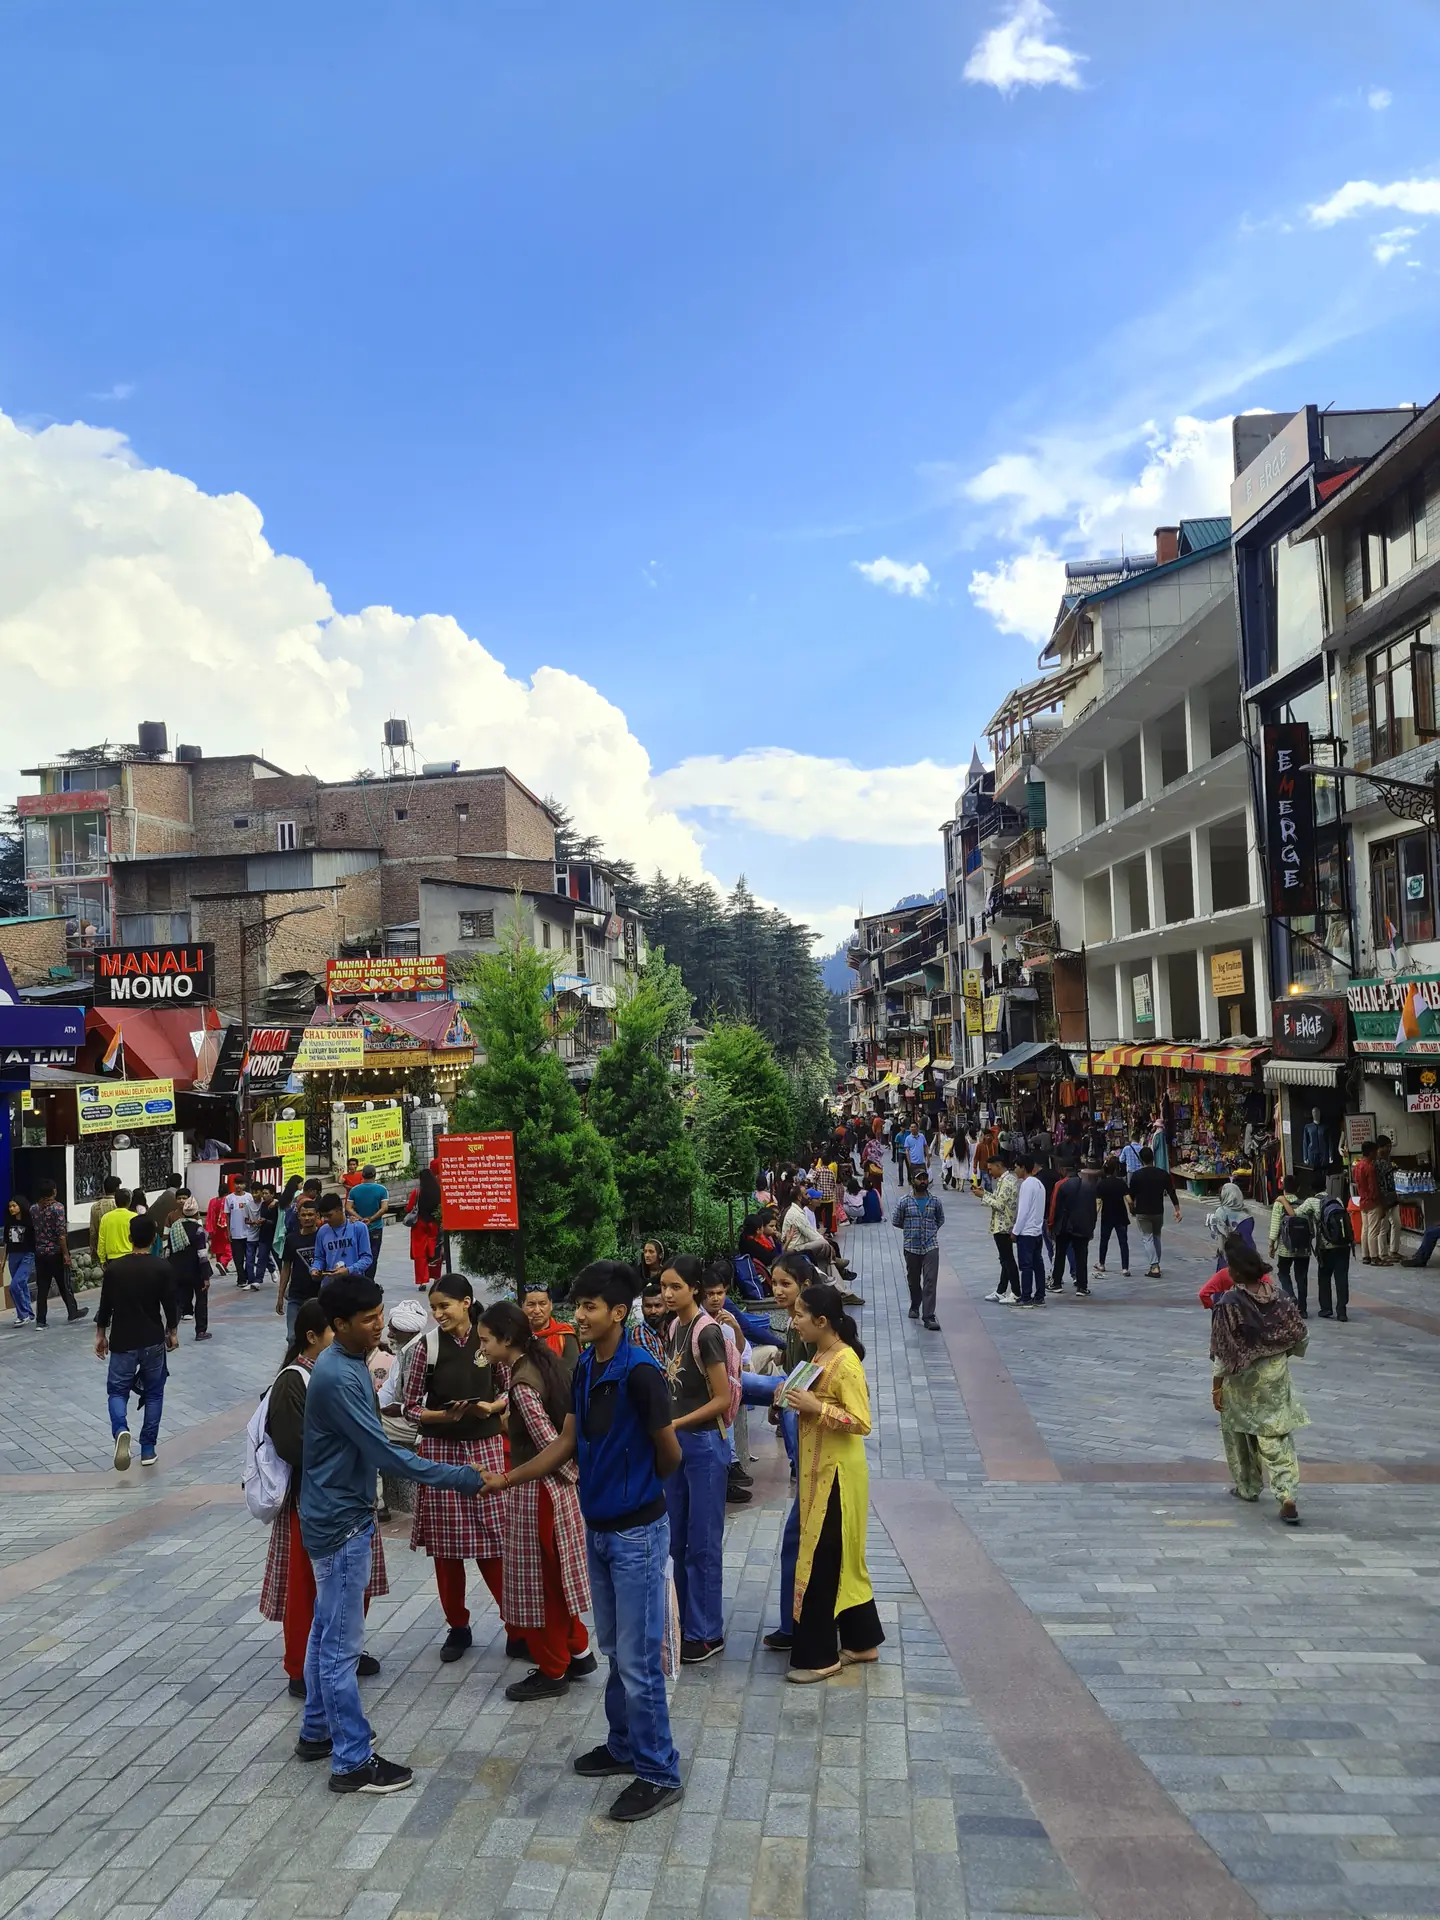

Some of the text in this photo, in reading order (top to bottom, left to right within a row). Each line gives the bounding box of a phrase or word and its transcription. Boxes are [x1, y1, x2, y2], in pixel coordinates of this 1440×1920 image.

[1278, 750, 1300, 888] EMERGE
[101, 949, 204, 976] MANALI
[336, 957, 437, 969] MANALI LOCAL WALNUT
[329, 966, 444, 979] MANALI LOCAL DISH SIDDU
[110, 975, 193, 1000] MOMO
[250, 1029, 291, 1052] MANALI
[5, 1049, 74, 1063] A.T.M.
[1364, 1061, 1380, 1074] LUNCH
[1384, 1062, 1402, 1075] DINNER
[115, 1088, 131, 1097] MANALI
[159, 1085, 167, 1093] BUS
[1411, 1103, 1421, 1111] All
[351, 1134, 369, 1145] MANALI
[373, 1132, 381, 1142] LEH
[384, 1128, 400, 1139] MANALI
[352, 1144, 369, 1156] MANALI
[468, 1144, 484, 1153] सूचना
[328, 1238, 353, 1251] GYMX
